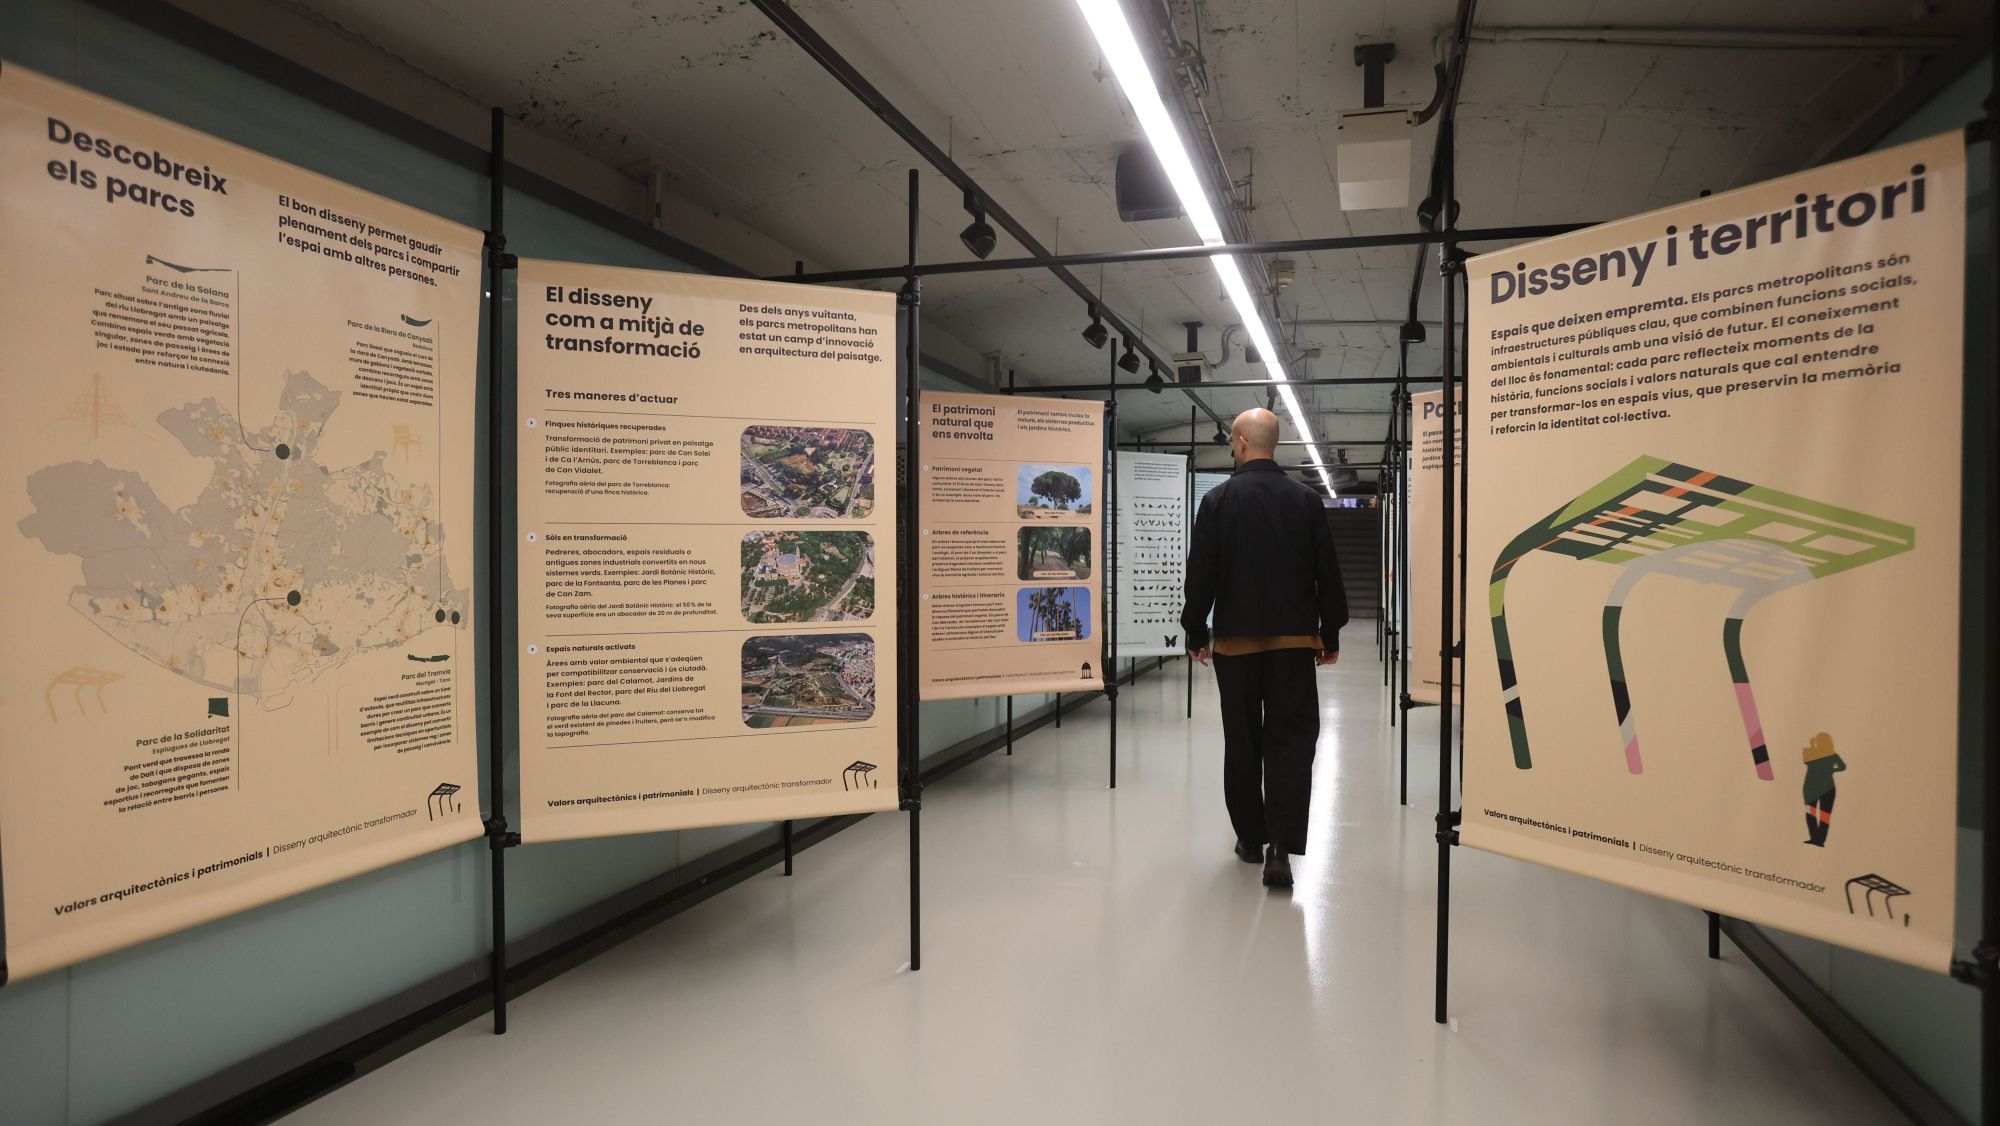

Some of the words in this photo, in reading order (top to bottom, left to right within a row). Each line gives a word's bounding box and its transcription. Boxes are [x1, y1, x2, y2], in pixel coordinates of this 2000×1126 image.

[47, 116, 227, 196] Descobreix
[46, 159, 97, 190] els
[106, 175, 195, 217] parcs
[278, 194, 289, 208] El
[292, 198, 317, 216] bon
[318, 208, 366, 234] disseny
[367, 224, 407, 245] permet
[408, 238, 443, 256] gaudir
[1490, 240, 1658, 305] Disseny
[1665, 224, 1678, 267] i
[1688, 163, 1926, 260] territori
[278, 215, 348, 243] plenament
[349, 235, 373, 251] dels
[374, 243, 404, 260] parcs
[406, 250, 409, 262] i
[410, 255, 460, 277] compartir
[322, 247, 353, 262] amb
[354, 255, 386, 272] altres
[388, 265, 437, 287] persones.
[94, 287, 112, 298] Parc
[113, 292, 135, 302] situat
[136, 297, 158, 307] sobre
[145, 274, 169, 287] Parc
[170, 280, 184, 290] de
[185, 282, 195, 292] la
[197, 285, 229, 299] Solana
[1491, 323, 1529, 341] Espais
[1531, 320, 1555, 335] que
[1557, 311, 1603, 328] deixen
[1604, 296, 1688, 319] empremta.
[1691, 291, 1710, 304] Els
[1712, 284, 1754, 303] parcs
[1757, 261, 1873, 291] metropolitans
[1877, 253, 1910, 268] són
[546, 285, 563, 303] El
[568, 286, 653, 315] disseny
[739, 303, 759, 313] Des
[760, 305, 783, 315] dels
[784, 308, 810, 319] anys
[811, 309, 857, 322] vuitanta,
[545, 312, 595, 329] com
[599, 316, 614, 330] a
[619, 315, 674, 339] mitjà
[678, 319, 704, 337] de
[738, 317, 754, 327] els
[755, 320, 785, 330] parcs
[787, 322, 857, 334] metropolitans
[858, 325, 878, 335] han
[1490, 334, 1576, 356] infraestructures
[1577, 324, 1636, 345] públiques
[1638, 318, 1670, 331] clau,
[1672, 313, 1698, 328] que
[1700, 300, 1773, 320] combinen
[1776, 287, 1847, 307] funcions
[1850, 274, 1917, 294] socials,
[545, 333, 701, 359] transformació
[738, 331, 767, 341] estat
[768, 334, 782, 342] un
[783, 335, 814, 347] camp
[1490, 354, 1551, 372] ambientals
[1552, 351, 1556, 362] i
[1557, 345, 1610, 361] culturals
[1612, 339, 1641, 353] amb
[1643, 336, 1669, 348] una
[1671, 328, 1704, 344] visió
[1705, 326, 1724, 338] de
[1726, 321, 1768, 335] futur.
[1771, 315, 1784, 328] El
[1787, 297, 1899, 325] coneixement
[738, 346, 753, 354] en
[753, 346, 819, 358] arquitectura
[819, 350, 835, 359] del
[836, 351, 882, 364] paisatge.
[544, 388, 571, 399] Tres
[573, 391, 626, 402] maneres
[932, 403, 941, 413] El
[943, 404, 996, 416] patrimoni
[545, 419, 575, 429] Finques
[576, 421, 619, 431] històriques
[619, 424, 666, 432] recuperades
[932, 416, 972, 427] natural
[973, 420, 994, 430] que
[932, 430, 951, 439] ens
[953, 430, 993, 441] envolta
[545, 434, 601, 443] Transformació
[601, 436, 611, 444] de
[612, 437, 649, 445] patrimoni
[649, 438, 671, 446] privat
[682, 439, 714, 448] paisatge
[545, 548, 581, 556] Pedreres,
[582, 548, 625, 556] abocadors,
[626, 548, 651, 556] espais
[545, 644, 571, 654] Espais
[604, 643, 636, 651] activats
[135, 737, 159, 747] Parc
[159, 734, 172, 743] de
[173, 733, 183, 741] la
[183, 725, 230, 739] Solidaritat
[152, 743, 188, 755] Esplugues
[199, 735, 230, 747] Llobregat
[547, 799, 575, 807] Valors
[576, 793, 637, 806] arquitectònics
[638, 792, 641, 800] i
[642, 789, 694, 802] patrimonials
[702, 787, 730, 795] Disseny
[731, 782, 780, 793] arquitectònic
[781, 778, 832, 788] transformador
[54, 897, 97, 916] Valors
[99, 872, 190, 903] arquitectònics
[191, 867, 195, 878] i
[197, 850, 263, 879] patrimonials
[273, 839, 307, 854] Disseny
[308, 823, 363, 844] arquitectònic
[363, 808, 417, 829] transformador
[1483, 808, 1508, 820] Valors
[1508, 815, 1567, 834] arquitectònics
[1568, 826, 1571, 835] i
[1572, 829, 1629, 848] patrimonials
[1639, 843, 1675, 860] Disseny
[1676, 853, 1742, 874] arquitectònic
[1744, 868, 1825, 893] transformador
